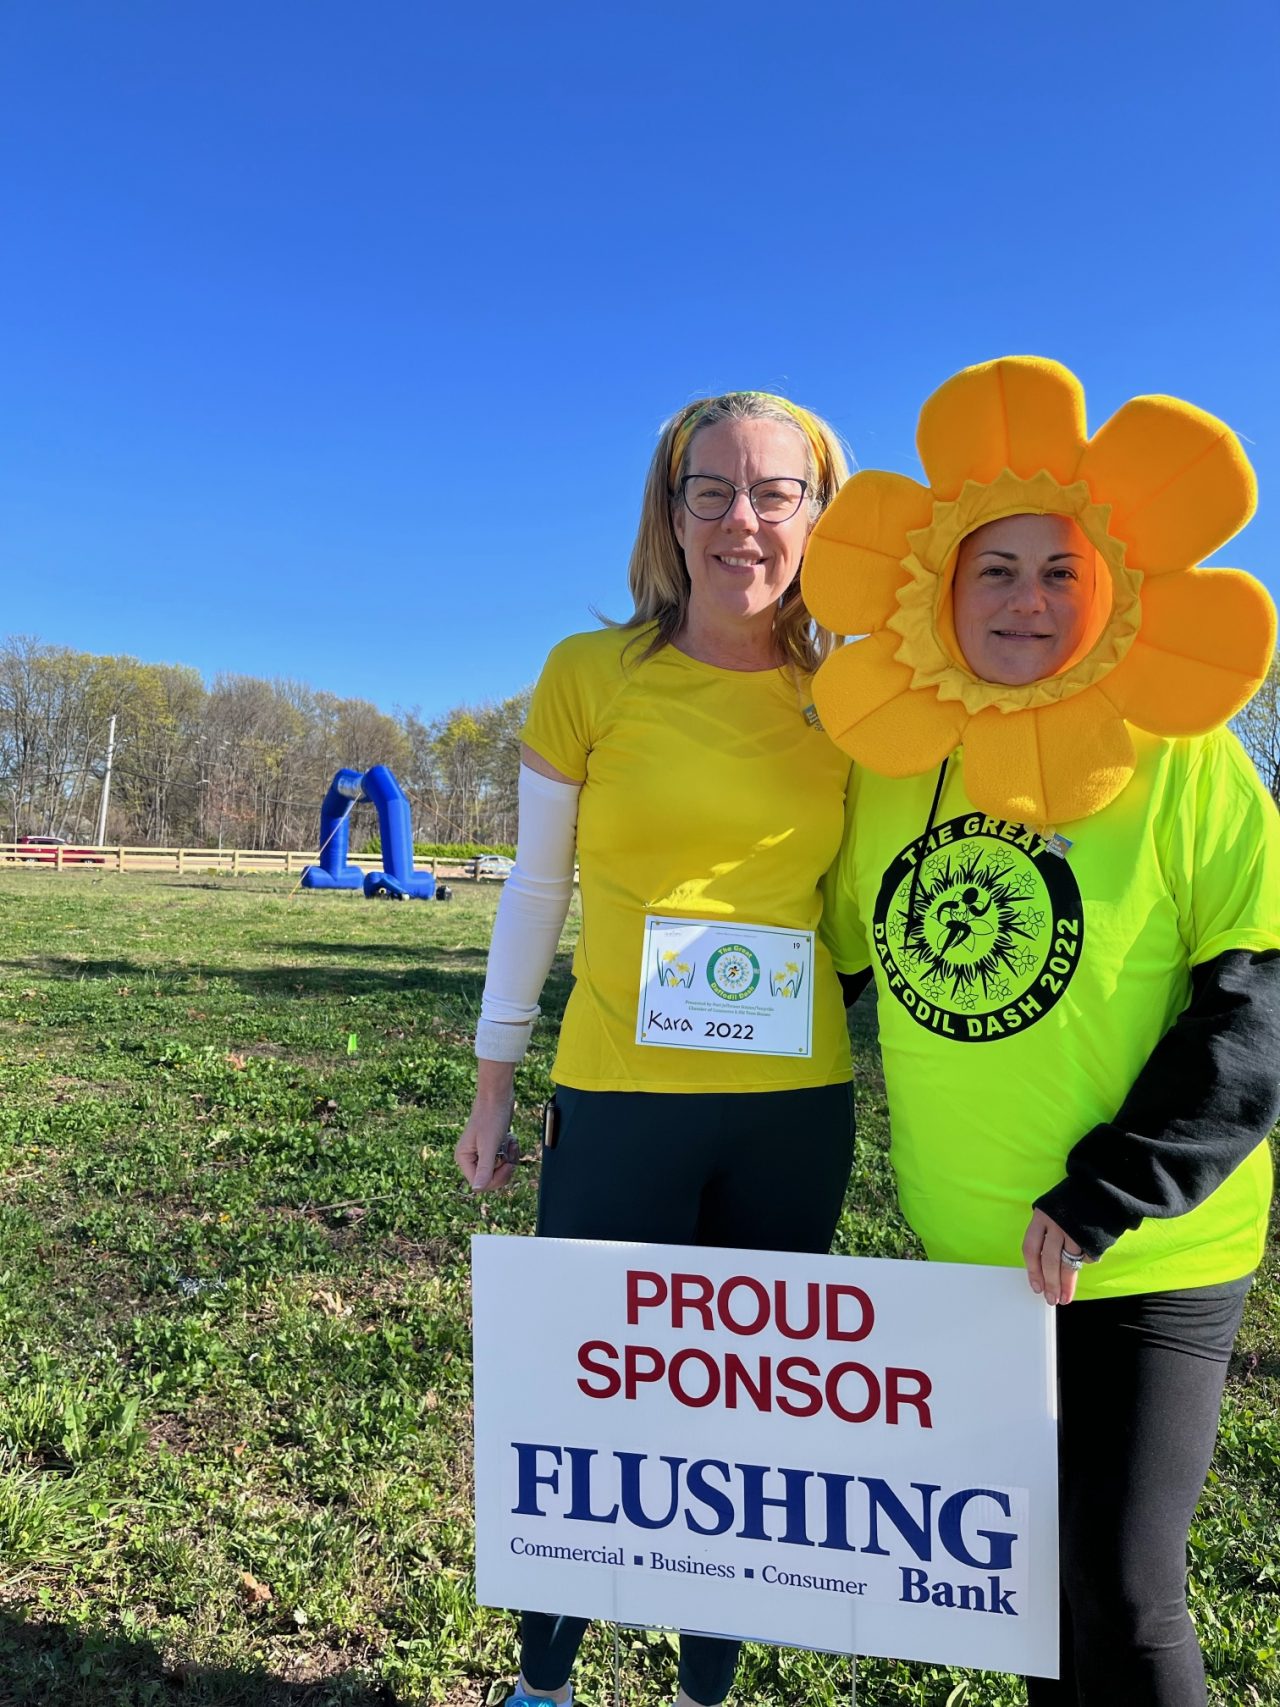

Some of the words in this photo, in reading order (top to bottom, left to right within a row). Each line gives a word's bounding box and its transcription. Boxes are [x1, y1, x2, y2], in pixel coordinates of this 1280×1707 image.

[963, 815, 1047, 858] GREAT
[717, 946, 732, 955] The
[733, 945, 753, 958] Great
[710, 982, 737, 1000] Daffodil
[738, 985, 755, 999] Dash
[874, 922, 955, 1034] DAFFODIL
[967, 994, 1043, 1037] DASH
[1040, 918, 1079, 995] 2022
[648, 1010, 693, 1032] Kara
[704, 1021, 754, 1040] 2022
[627, 1270, 875, 1342] PROUD
[578, 1340, 933, 1429] SPONSOR
[511, 1442, 1018, 1571] FLUSHING
[510, 1537, 625, 1566] Commercial
[650, 1551, 736, 1579] Business
[762, 1565, 868, 1596] Consumer
[899, 1566, 1019, 1616] Bank
